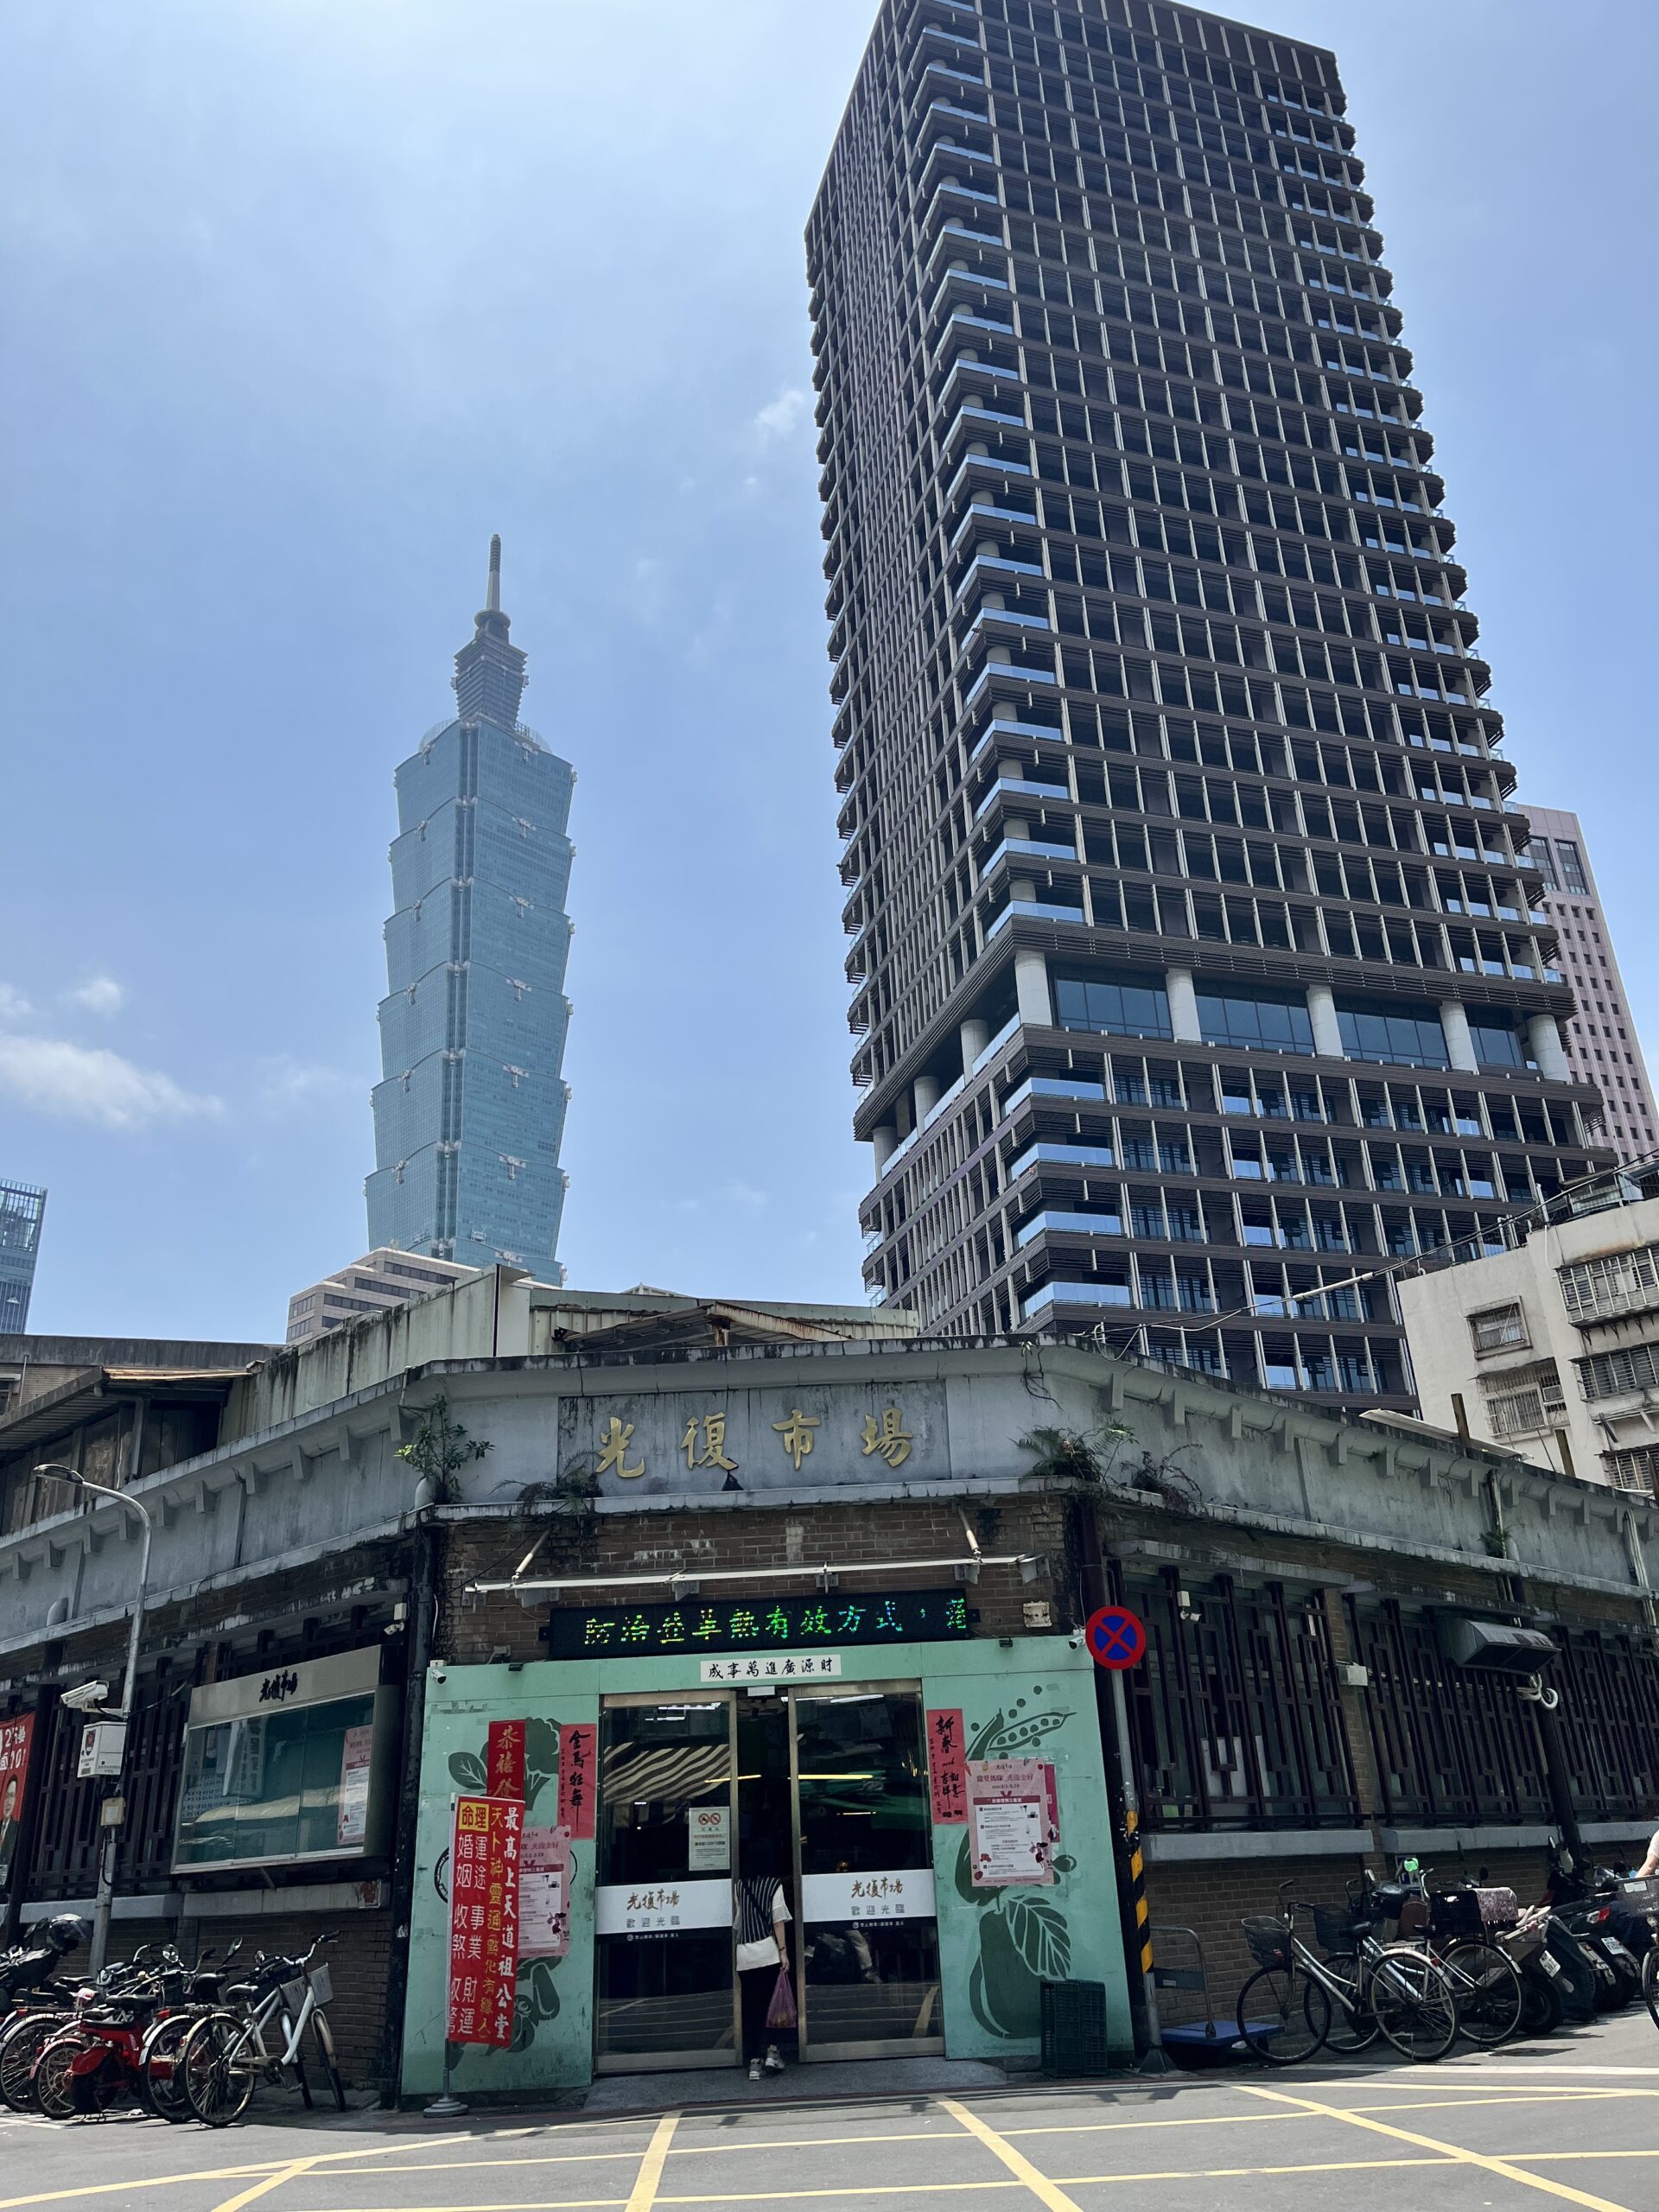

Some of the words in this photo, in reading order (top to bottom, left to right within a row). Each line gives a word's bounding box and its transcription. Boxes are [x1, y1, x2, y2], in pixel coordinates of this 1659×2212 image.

[595, 1408, 913, 1478] 光復市場
[461, 1805, 486, 1829] 命理
[455, 1834, 474, 1888] 婚姻
[474, 1836, 488, 1890] 運途
[851, 1876, 904, 1899] 光復市場
[494, 1807, 519, 2040] 最高上天道祖公堂
[626, 1888, 680, 1911] 光復市場
[626, 1916, 681, 1929] 歡迎光臨
[851, 1904, 906, 1916] 歡迎光臨
[467, 1905, 485, 1960] 事業
[458, 1976, 477, 2034] 財運
